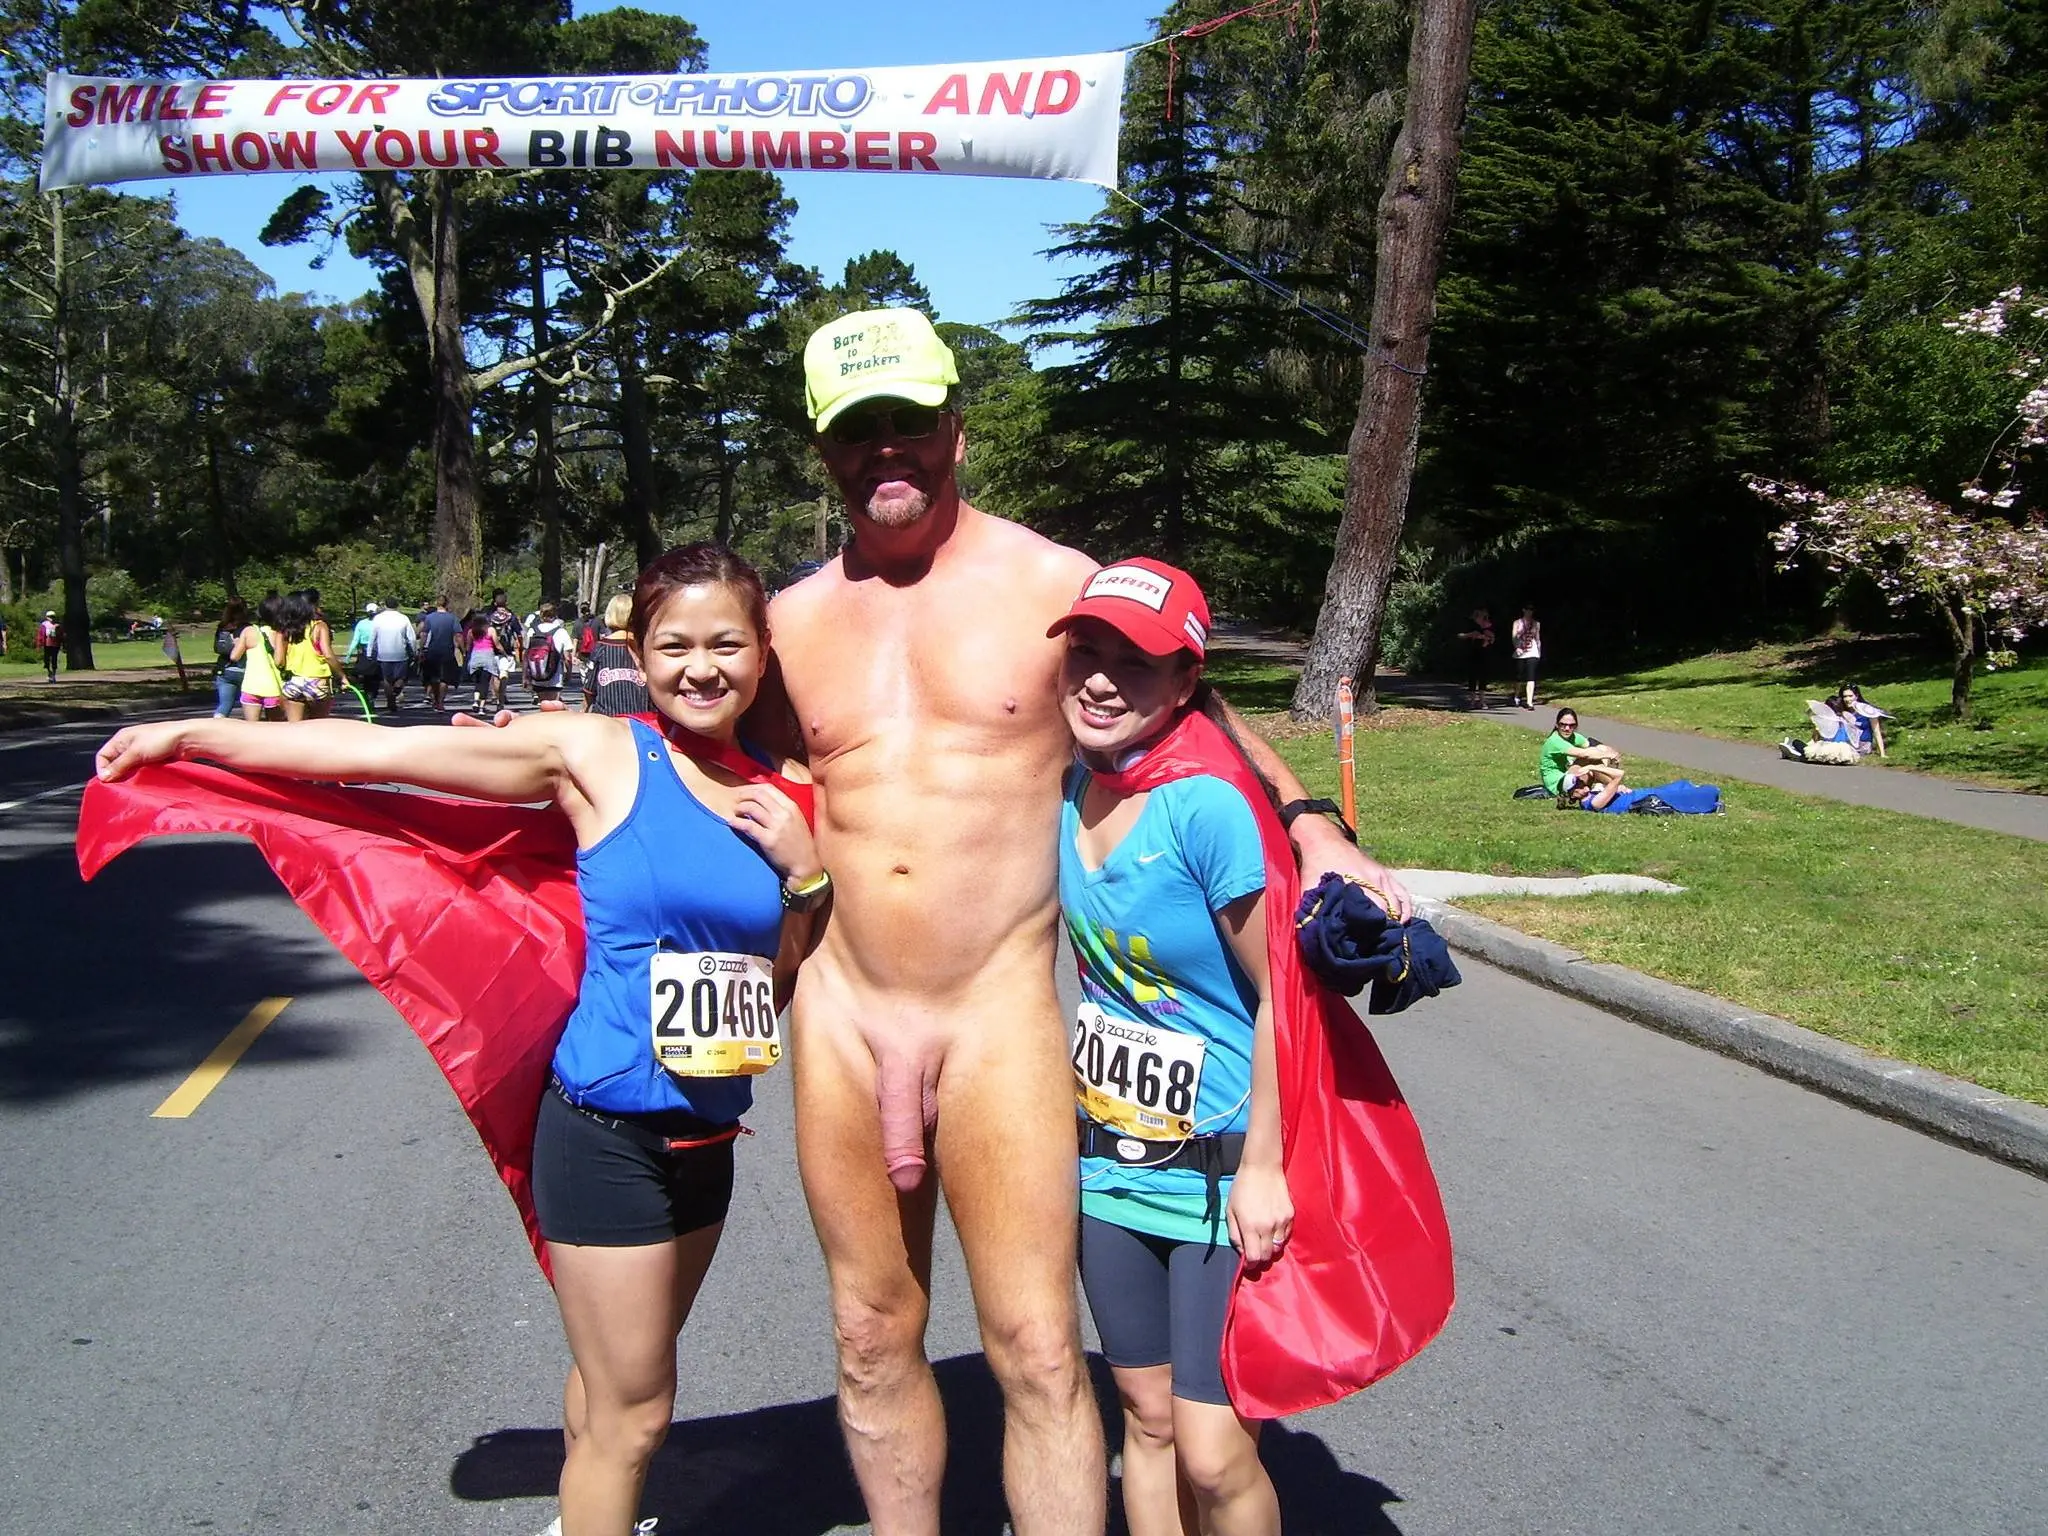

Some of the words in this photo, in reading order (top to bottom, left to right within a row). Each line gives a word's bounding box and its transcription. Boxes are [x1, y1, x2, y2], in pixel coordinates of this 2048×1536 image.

[66, 84, 235, 128] SMILE
[264, 83, 401, 116] FOR
[427, 80, 631, 118] SPORT
[652, 74, 876, 119] PHOTO
[922, 69, 1081, 116] AND
[160, 130, 319, 174] SHOW
[335, 129, 508, 168] YOUR
[528, 129, 633, 168] BIB
[653, 130, 941, 171] NUMBER
[833, 332, 864, 350] Bare
[840, 355, 900, 376] Breakers
[847, 348, 858, 359] to
[655, 978, 774, 1039] 20466
[1107, 1023, 1158, 1047] zazzle
[768, 1043, 780, 1058] C
[1072, 1019, 1195, 1116] 20468
